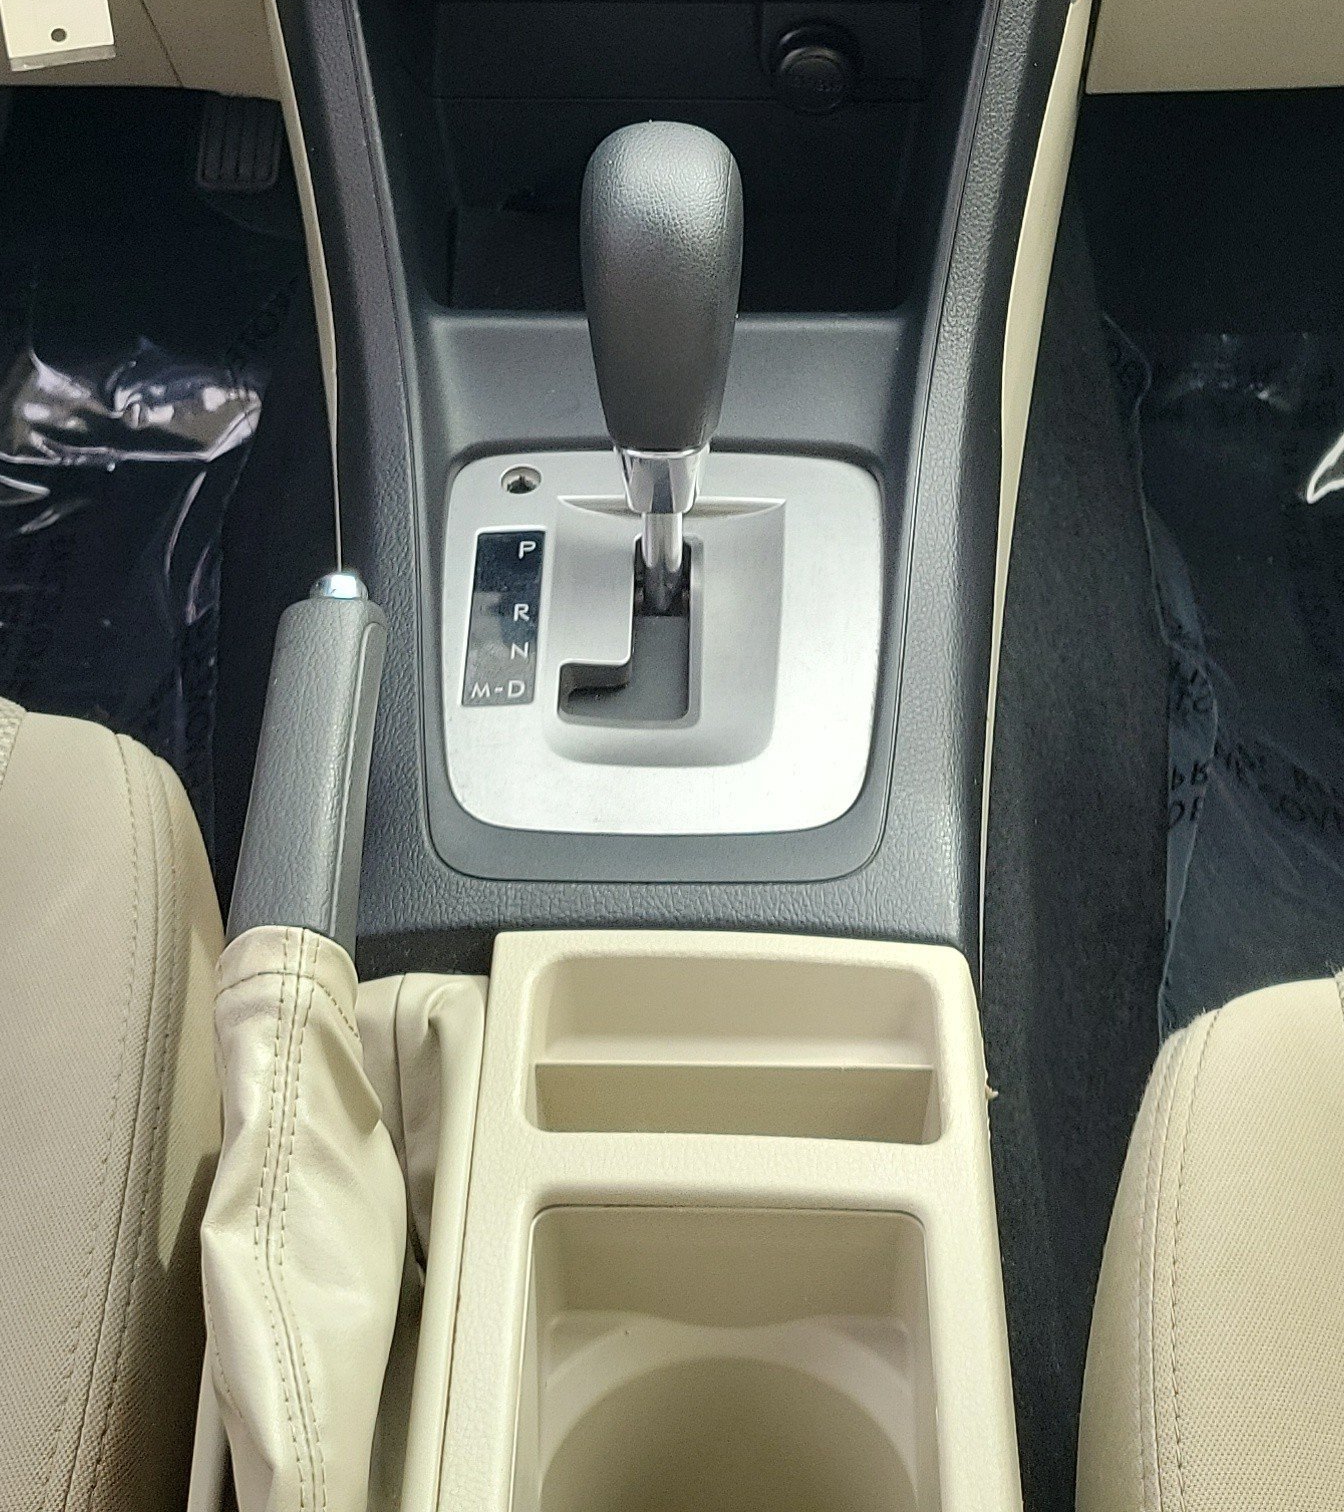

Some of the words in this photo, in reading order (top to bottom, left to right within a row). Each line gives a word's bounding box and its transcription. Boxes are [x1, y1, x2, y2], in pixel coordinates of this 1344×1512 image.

[518, 541, 536, 559] P
[513, 603, 530, 621] R
[510, 641, 529, 660] N
